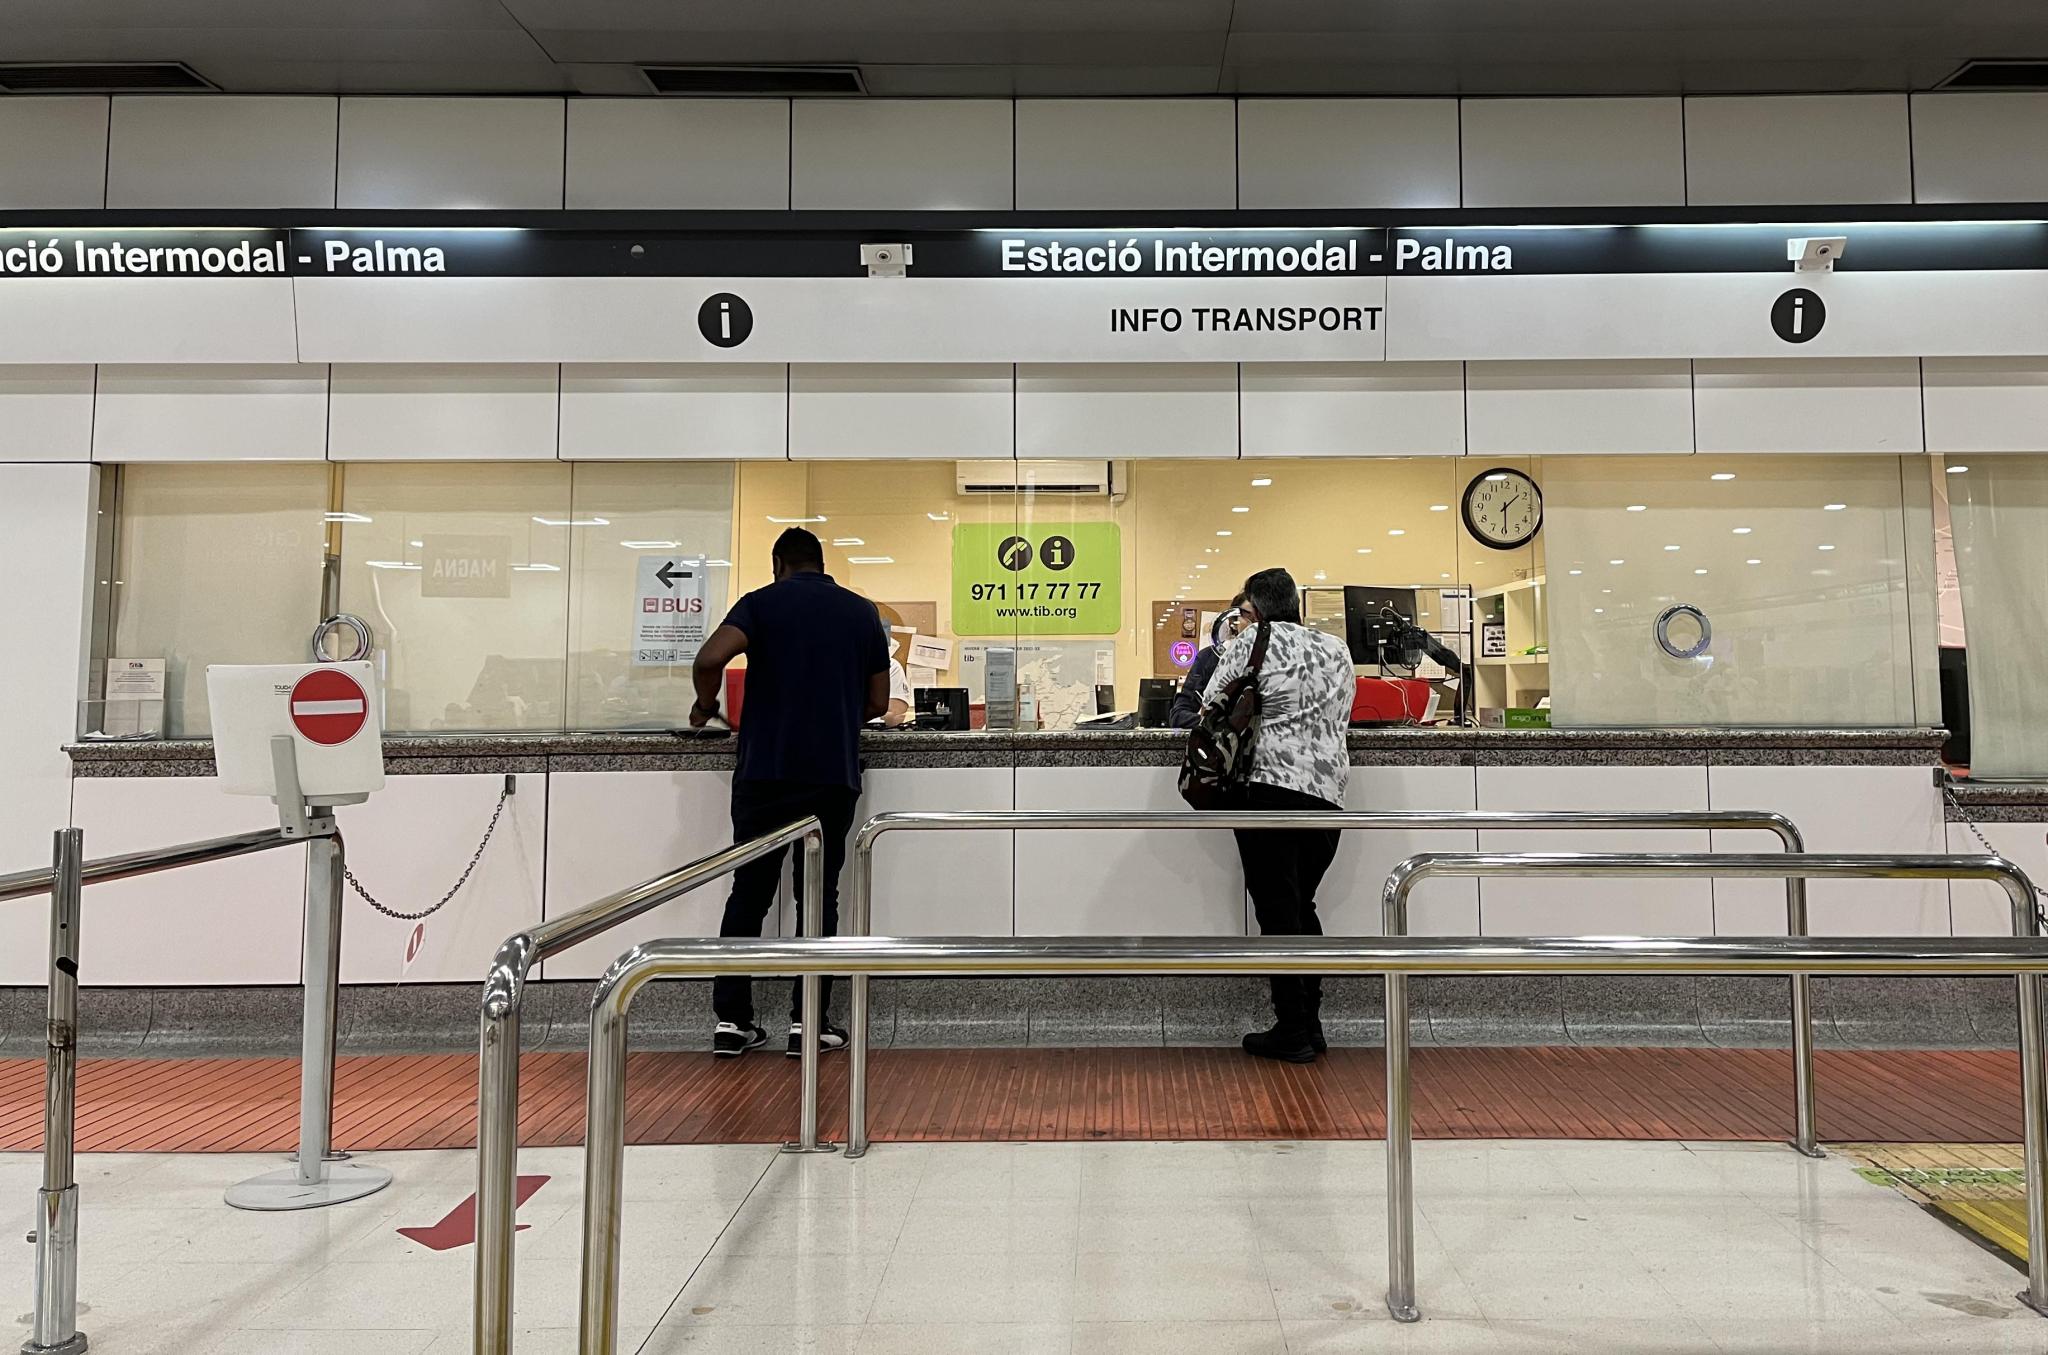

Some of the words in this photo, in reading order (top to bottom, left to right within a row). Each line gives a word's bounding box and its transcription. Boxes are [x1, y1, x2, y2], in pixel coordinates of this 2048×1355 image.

[0, 239, 63, 273] ció
[75, 240, 285, 273] Intermodal
[298, 255, 311, 263] -
[326, 239, 445, 273] Palma
[1001, 239, 1142, 272] Estació
[1154, 239, 1356, 272] Intermodal
[1370, 254, 1382, 262] -
[1396, 239, 1512, 271] Palma
[1111, 307, 1182, 332] INFO
[1192, 307, 1382, 332] TRANSPORT
[1490, 484, 1498, 493] 11
[1500, 481, 1511, 490] 12
[1482, 493, 1491, 501] 10
[1522, 492, 1528, 500] 2
[1477, 503, 1484, 511] 9
[1481, 515, 1488, 523] 8
[1522, 515, 1528, 523] 4
[1491, 523, 1496, 531] 7
[1515, 524, 1520, 534] 5
[971, 584, 1006, 600] 971
[1017, 583, 1039, 600] 17
[1046, 583, 1070, 600] 77
[1077, 582, 1101, 599] 77
[662, 597, 703, 613] BUS
[996, 605, 1077, 619] www.tib.org
